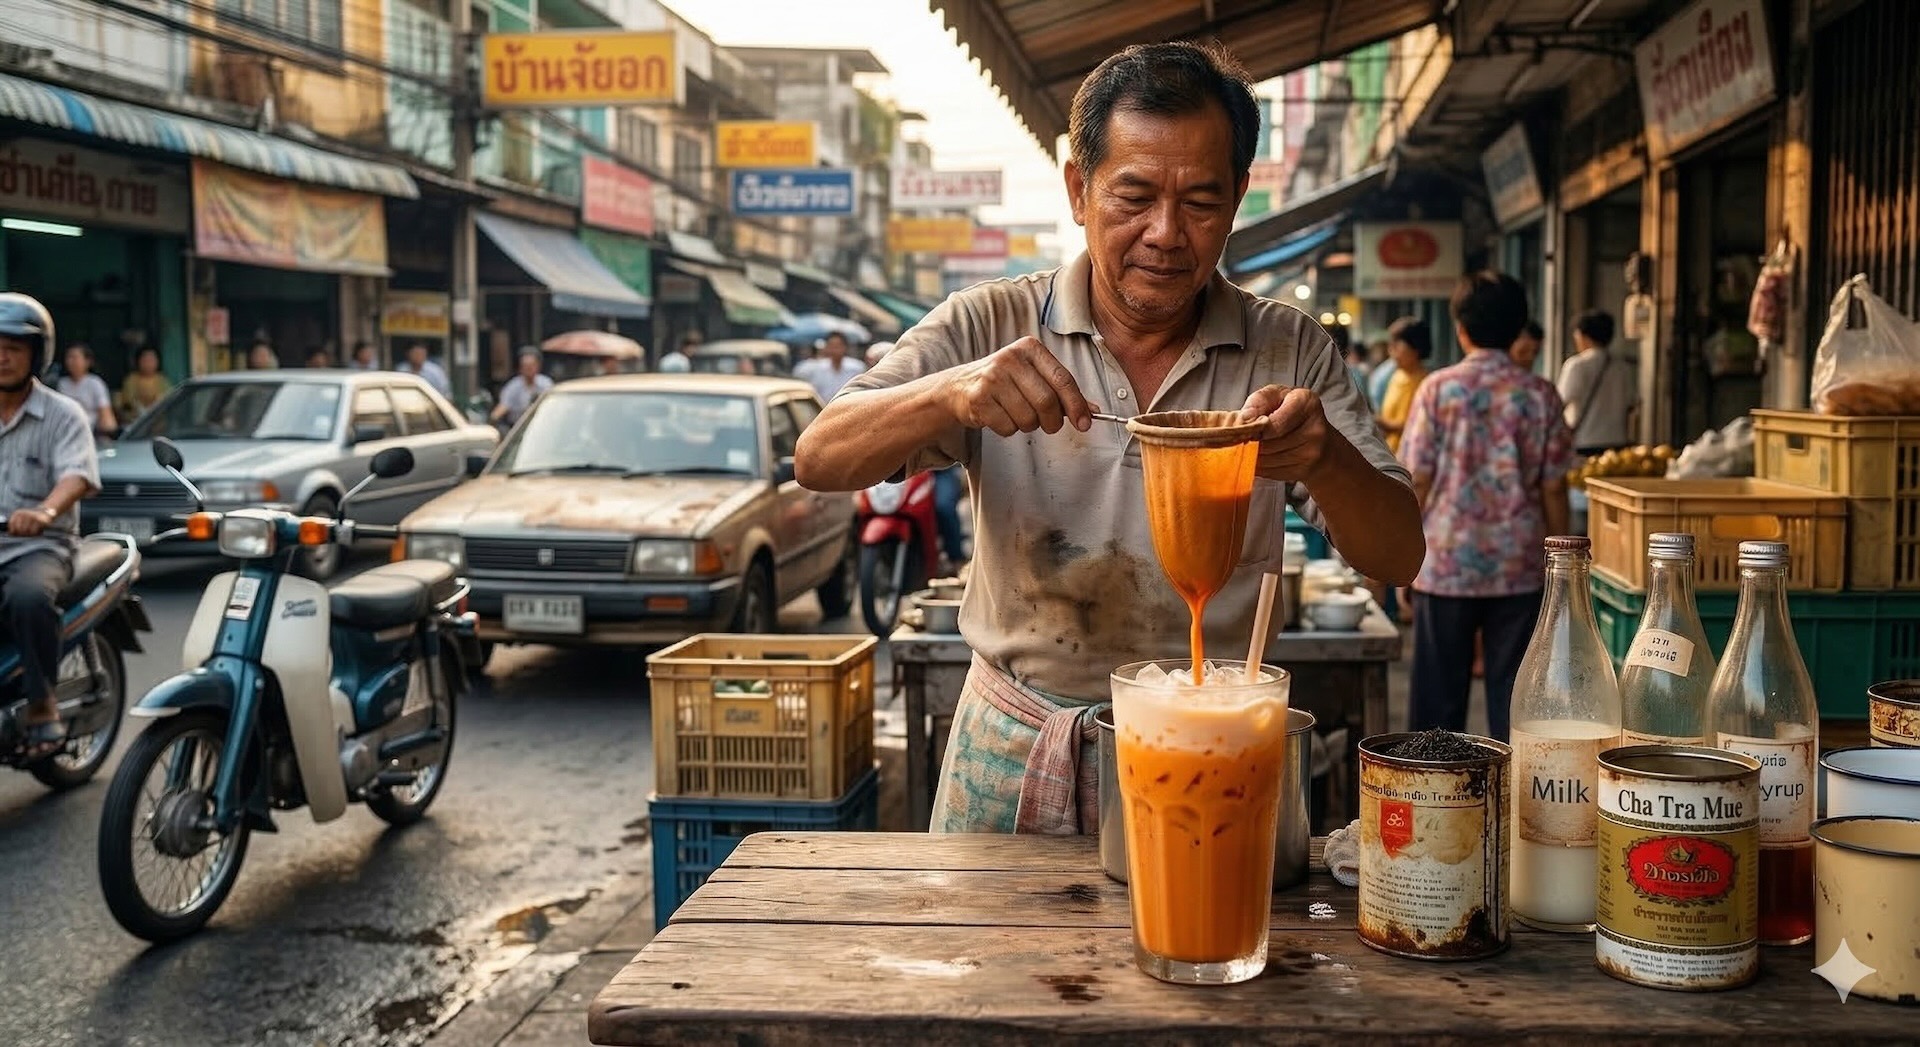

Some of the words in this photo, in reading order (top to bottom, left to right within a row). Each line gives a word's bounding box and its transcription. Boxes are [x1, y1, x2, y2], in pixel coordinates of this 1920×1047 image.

[1531, 775, 1591, 804] Milk
[1759, 783, 1804, 802] yrup
[1618, 789, 1653, 816] Cha
[1658, 795, 1696, 820] Tra
[1702, 796, 1743, 820] Mue
